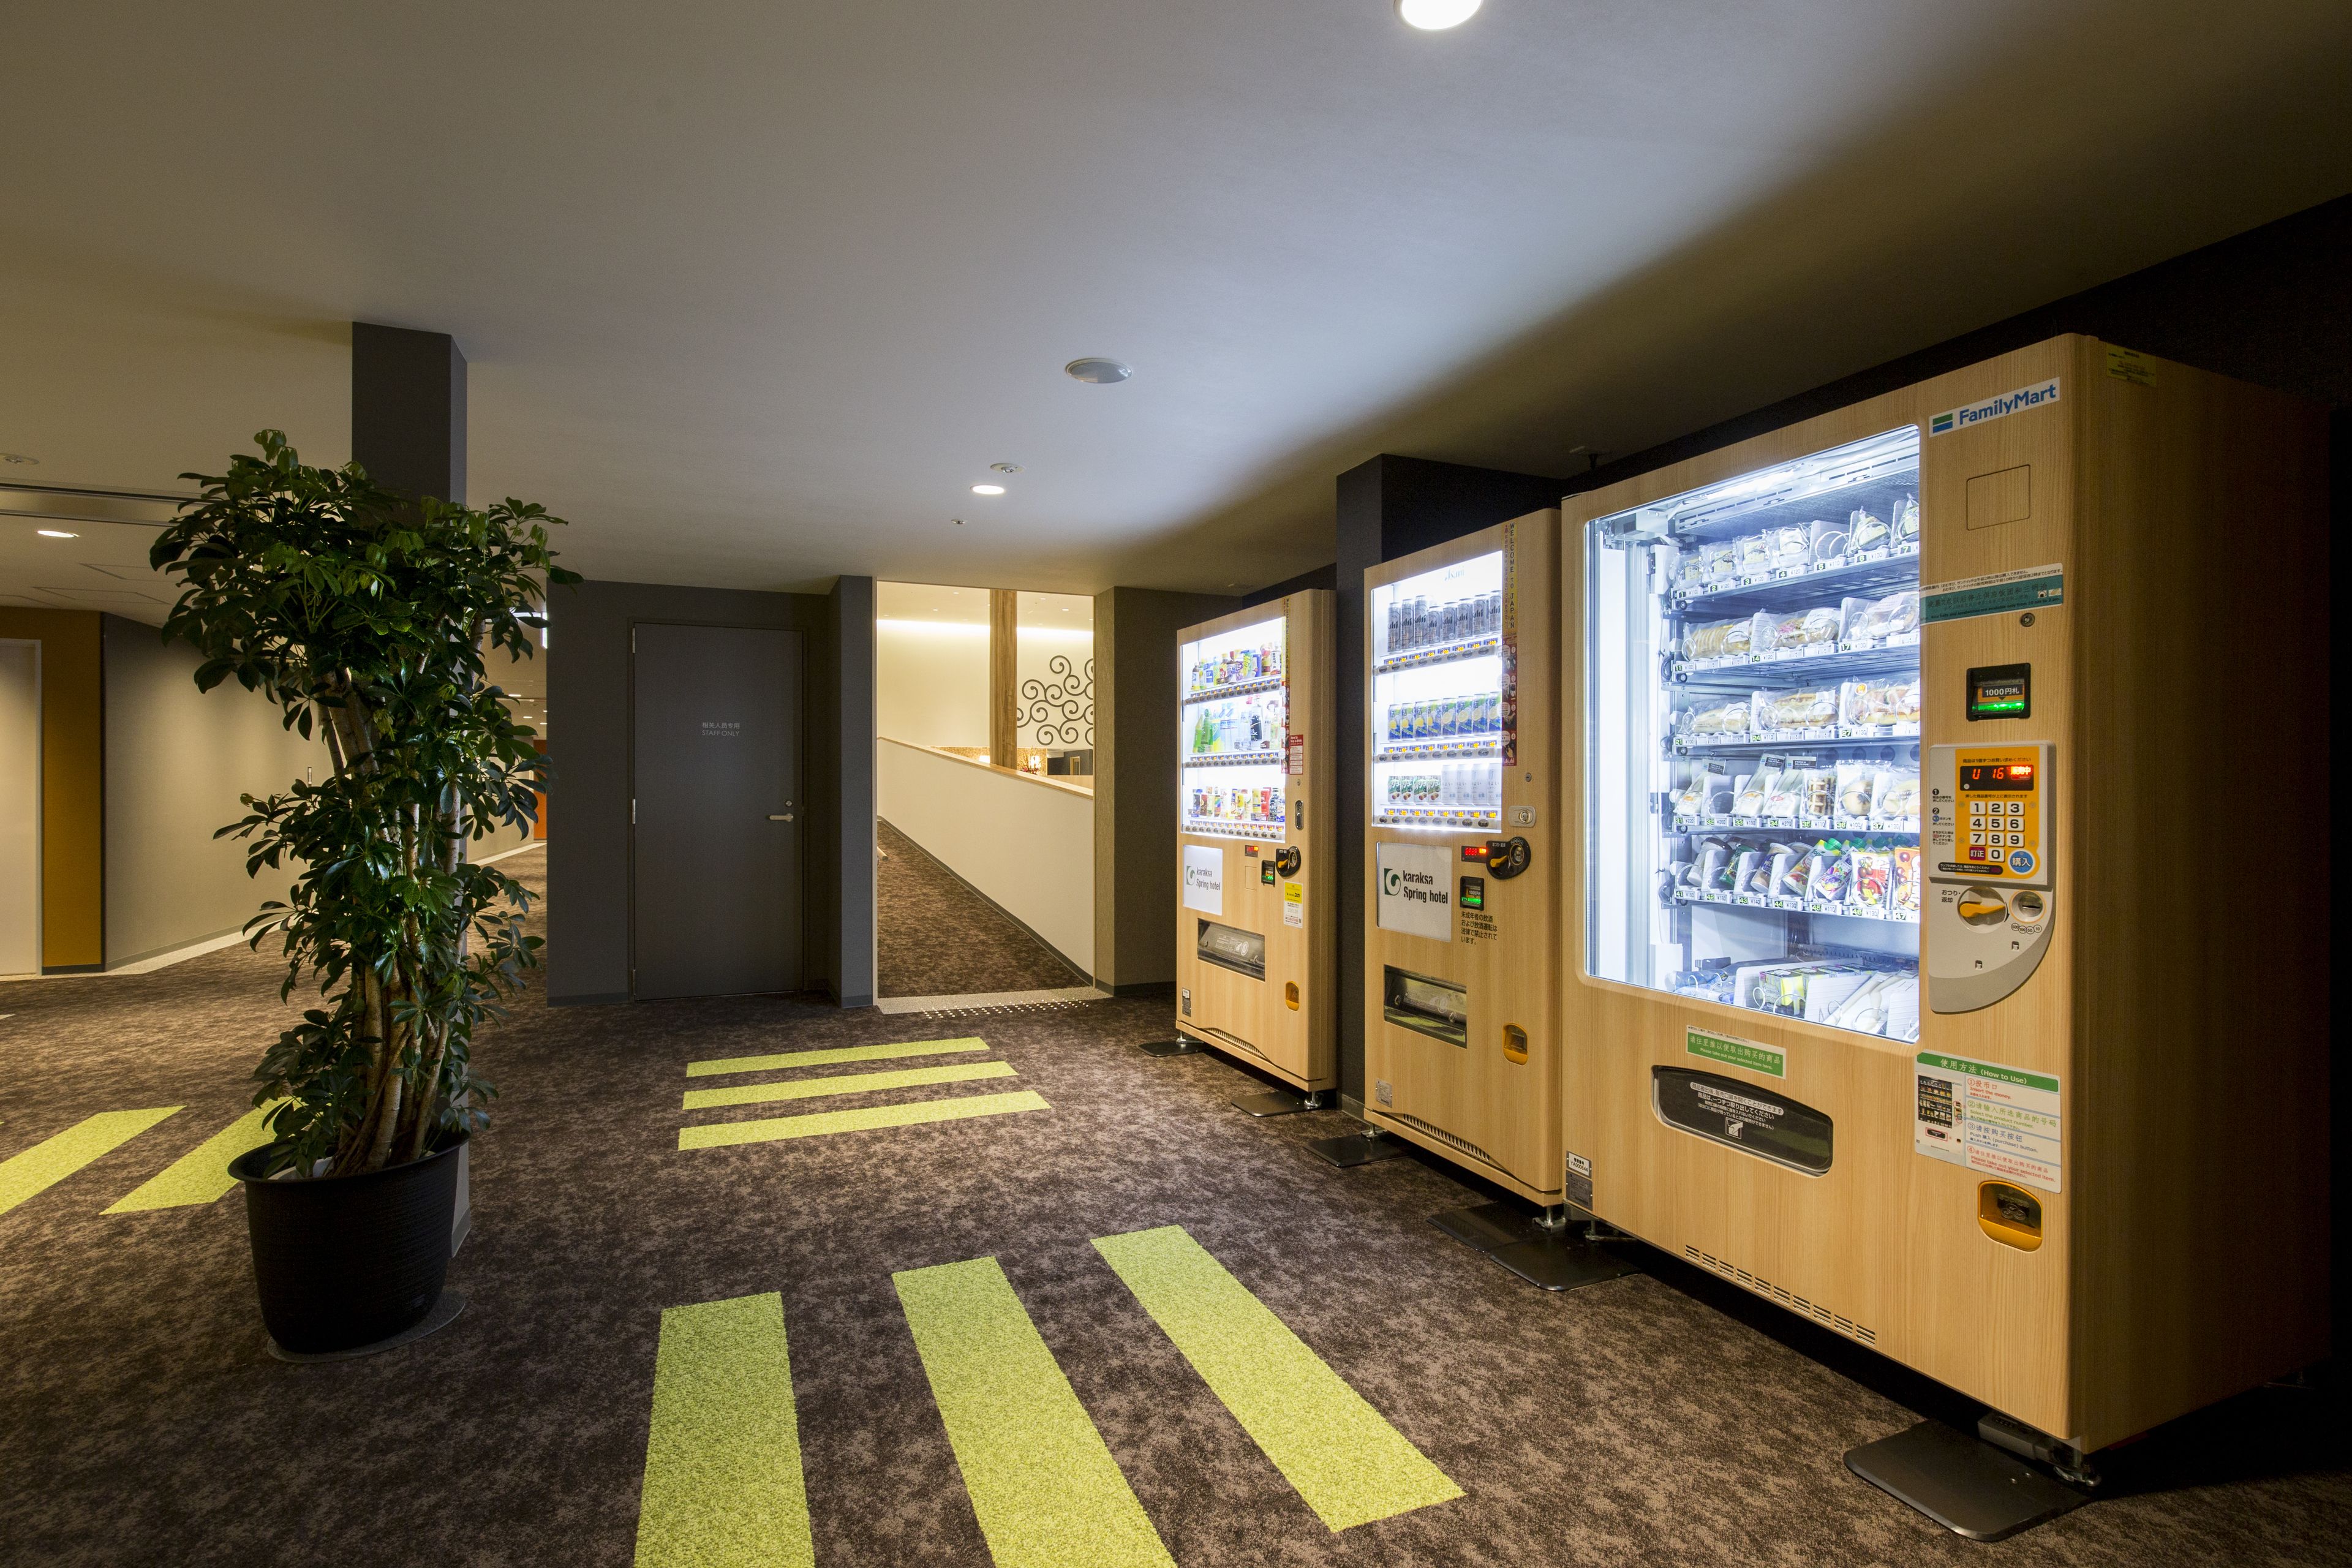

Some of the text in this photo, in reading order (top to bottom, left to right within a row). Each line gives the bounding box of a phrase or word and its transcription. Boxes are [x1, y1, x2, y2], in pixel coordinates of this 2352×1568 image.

[1960, 384, 2056, 425] FamilyMart
[1510, 577, 1514, 589] TO
[1985, 687, 2020, 696] 1000円札
[1992, 767, 2004, 780] 16
[1974, 803, 1979, 813] 1
[1991, 803, 2000, 813] 2
[2010, 803, 2019, 813] 3
[1972, 818, 1982, 827] 4
[1991, 818, 2000, 828] 5
[2010, 819, 2019, 829] 6
[1973, 834, 1981, 843] 7
[1991, 834, 2000, 844] 8
[2010, 835, 2019, 845] 9
[1991, 849, 2000, 859] 0
[2012, 857, 2031, 867] 購入
[1196, 867, 1213, 877] karaksa
[1403, 870, 1433, 885] karaksa
[1196, 879, 1221, 891] Spring hotel
[1403, 886, 1449, 904] Spring hotel
[1461, 911, 1493, 923] 未成年者の飲酒
[1461, 919, 1498, 932] および飲酒運転は
[1461, 927, 1498, 941] 法律で禁止されて
[1461, 936, 1477, 945] います。
[1940, 1058, 1977, 1074] 使用方法
[1980, 1069, 1999, 1079] (How
[2010, 1076, 2027, 1085] Use)
[1994, 1115, 2013, 1123] product
[1992, 1137, 2019, 1148] (purchase)
[2021, 1168, 2041, 1178] selected
